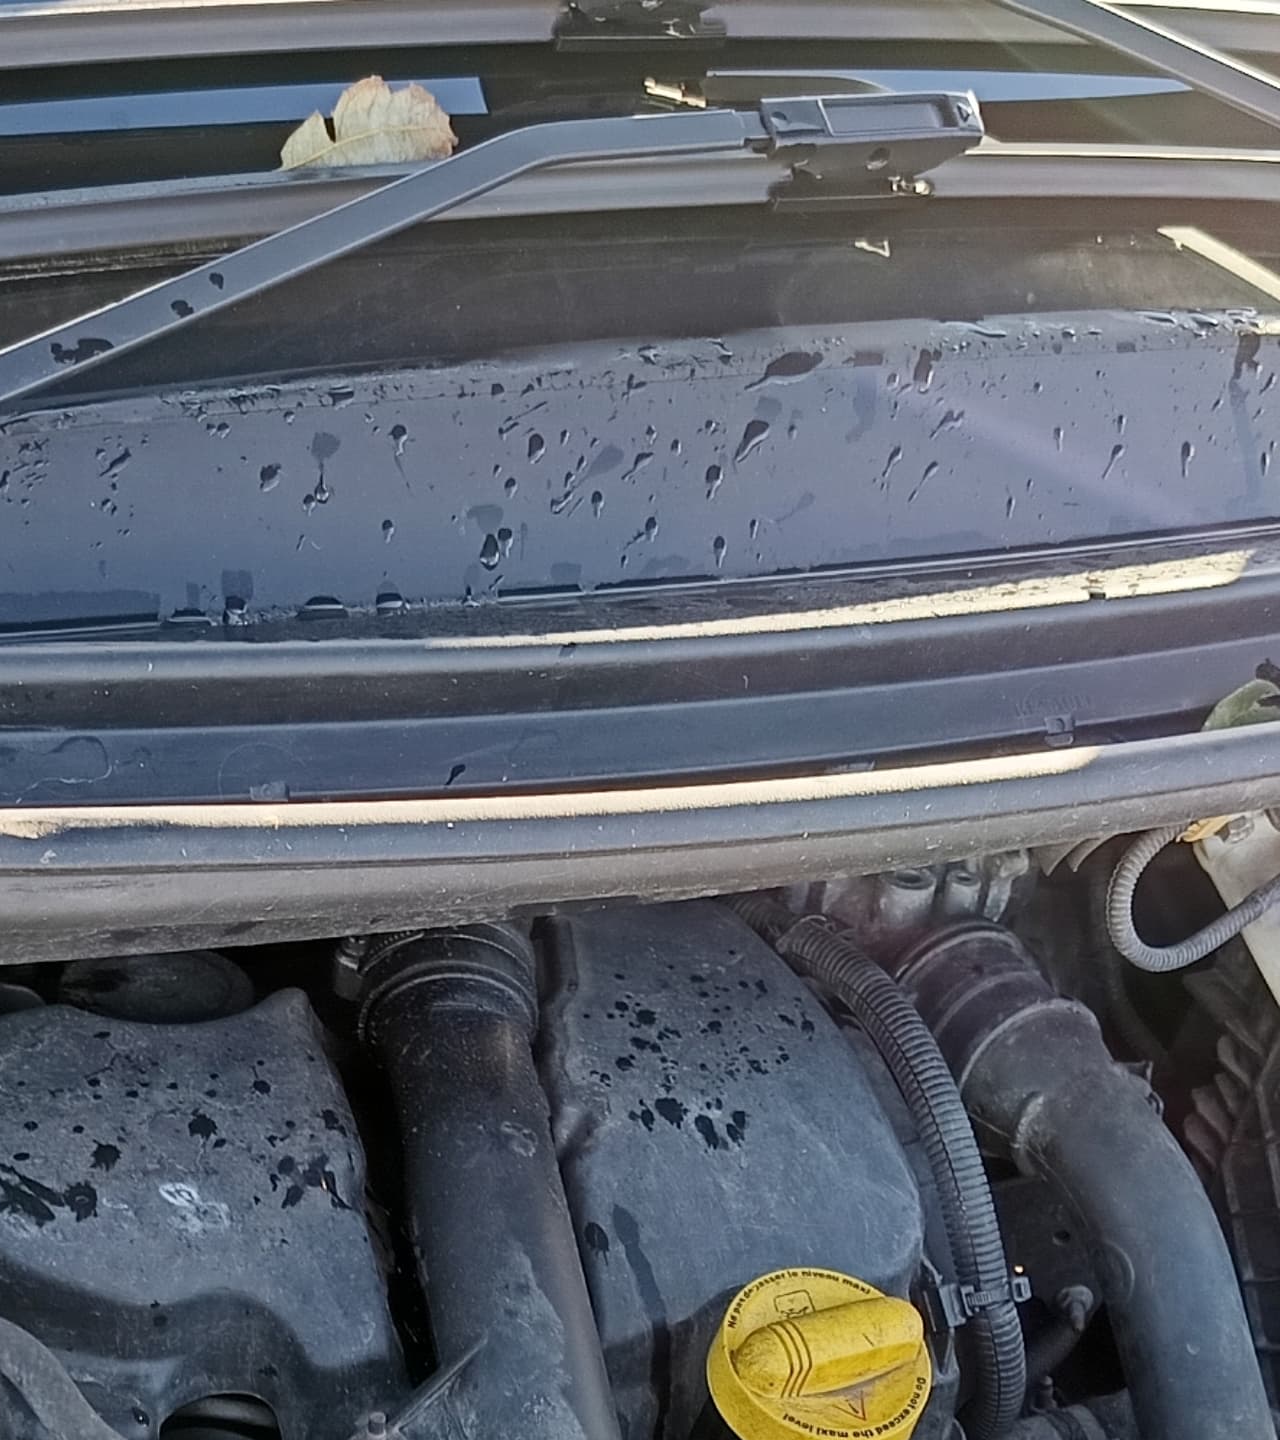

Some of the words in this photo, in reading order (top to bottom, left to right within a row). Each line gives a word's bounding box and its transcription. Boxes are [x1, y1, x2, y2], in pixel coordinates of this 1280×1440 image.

[787, 1270, 799, 1278] le
[801, 1270, 841, 1282] niveau
[842, 1277, 871, 1295] maxi
[915, 1376, 927, 1391] Do
[910, 1393, 921, 1410] not
[782, 1413, 813, 1433] level
[875, 1409, 911, 1433] exceed
[816, 1426, 849, 1438] maxi
[852, 1429, 874, 1439] the
